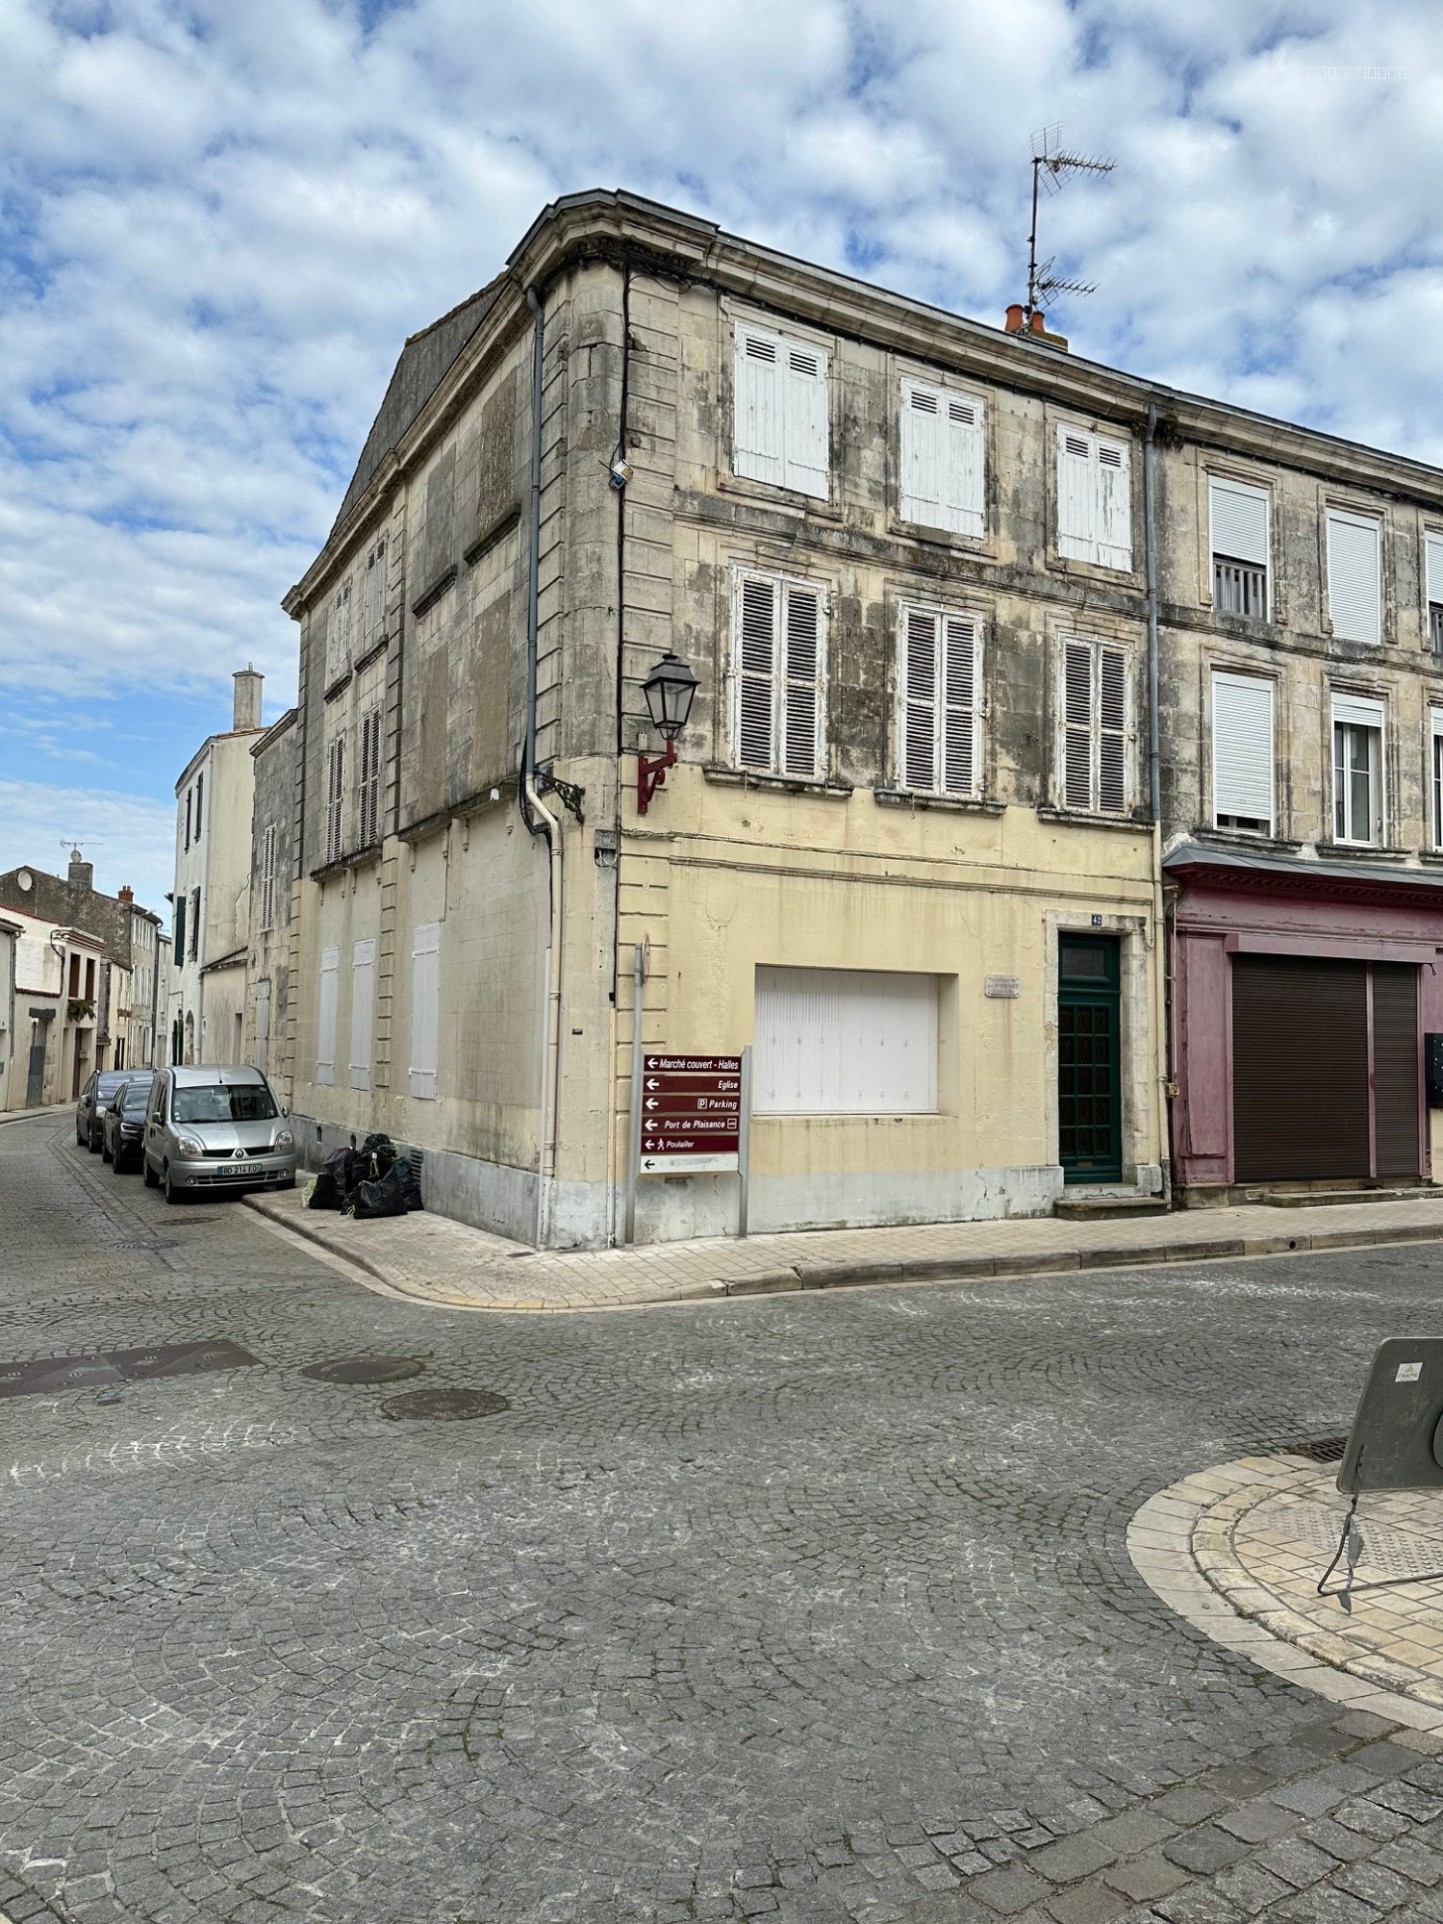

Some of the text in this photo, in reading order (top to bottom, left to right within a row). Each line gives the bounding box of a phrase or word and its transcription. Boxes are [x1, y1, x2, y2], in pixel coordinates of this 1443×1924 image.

[1092, 916, 1102, 924] 42
[659, 1058, 686, 1069] Marché
[686, 1059, 712, 1069] couvert
[718, 1060, 739, 1070] Halles
[718, 1080, 738, 1090] Eglise
[709, 1100, 738, 1110] Parking
[664, 1120, 726, 1129] Port de Plaisance
